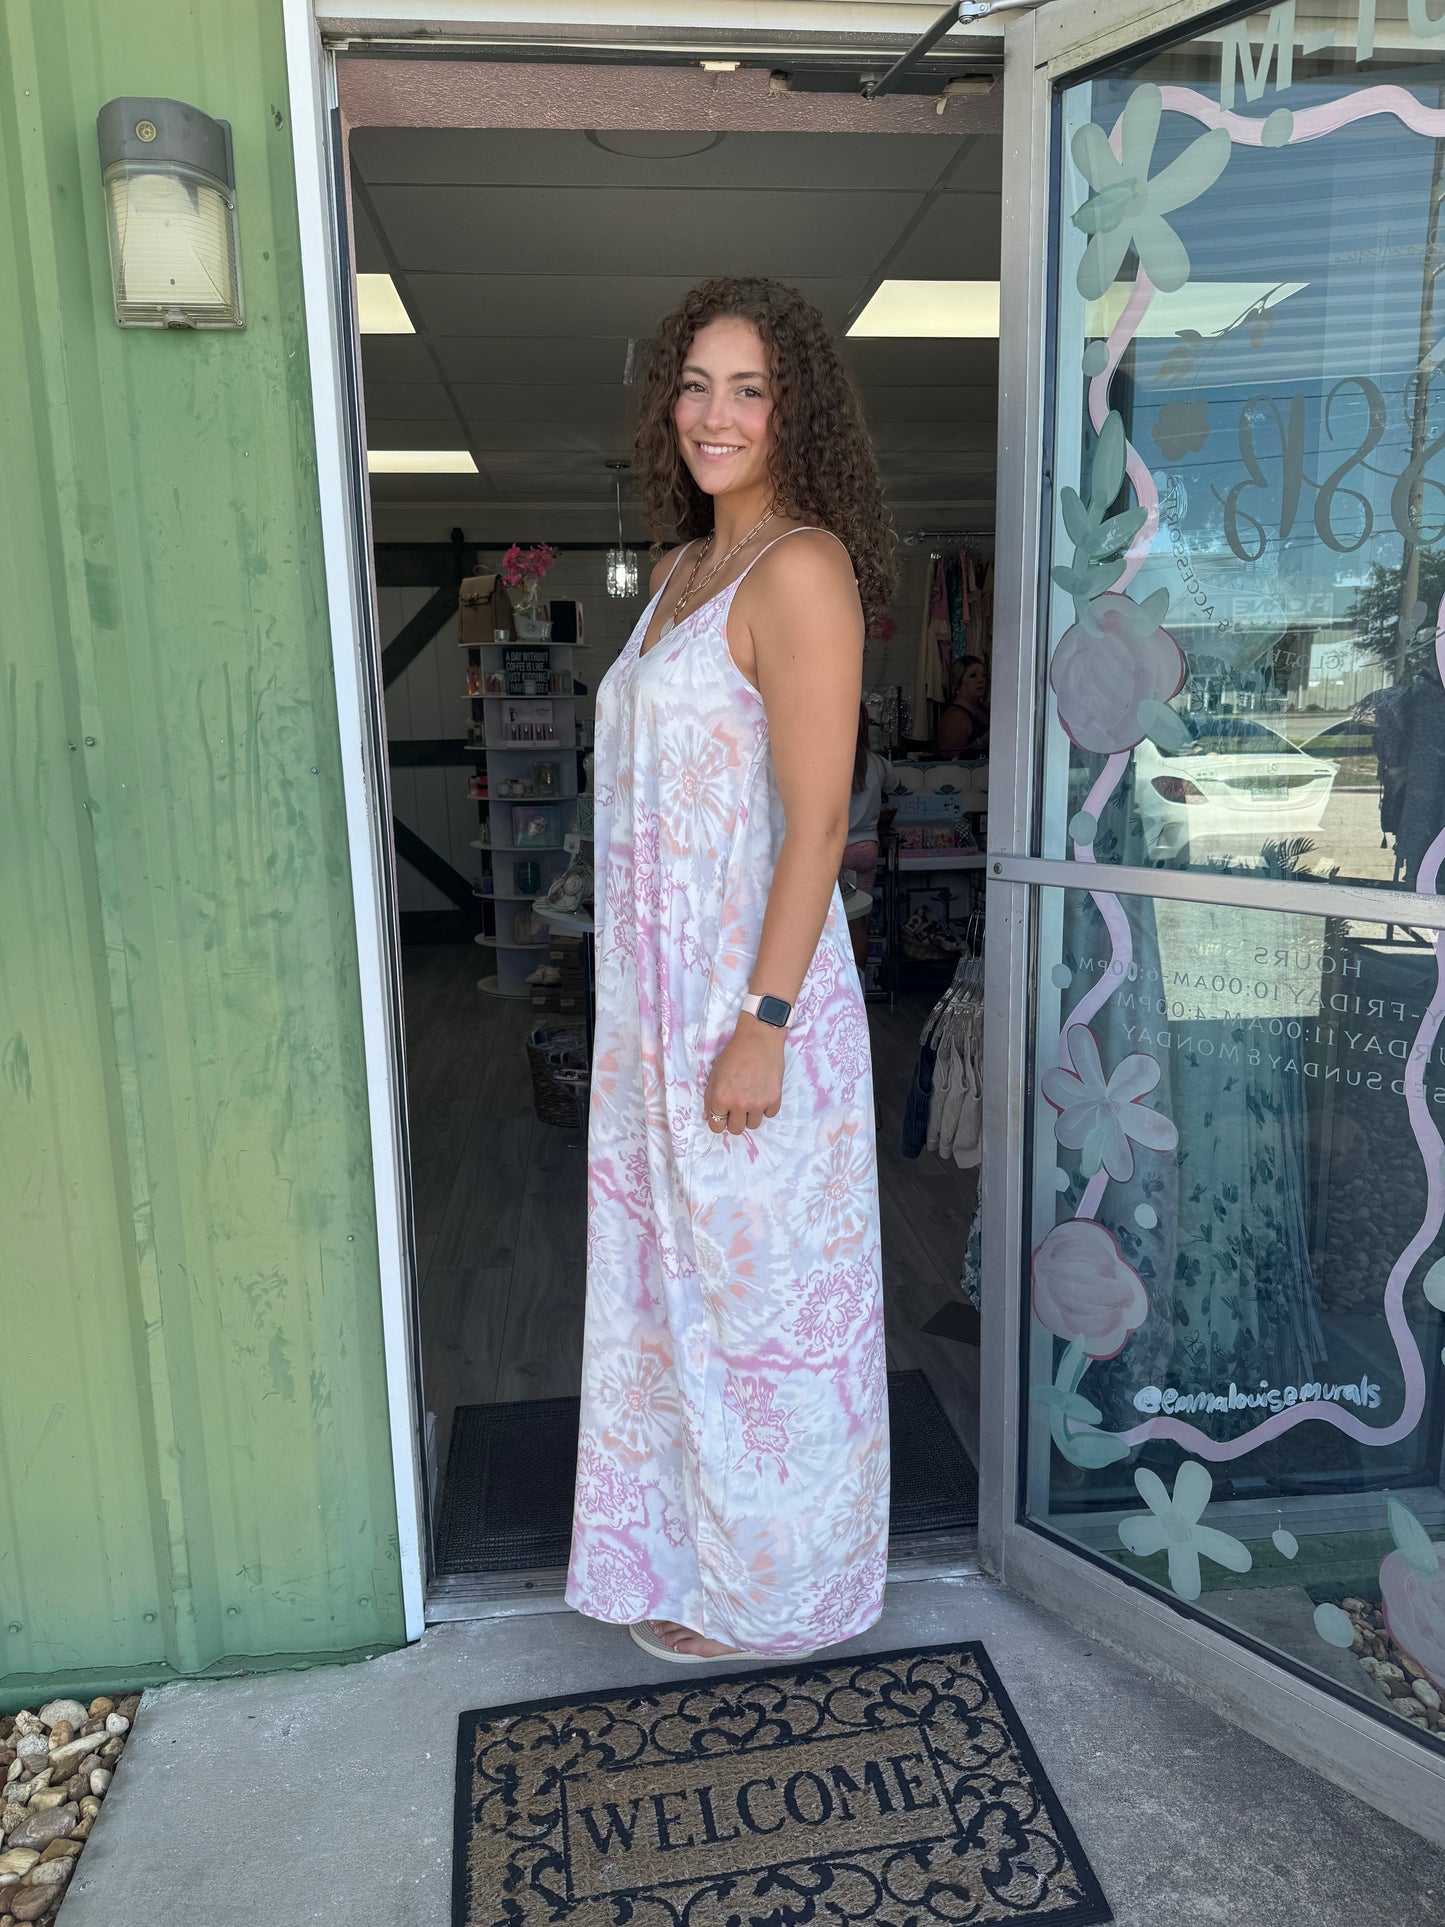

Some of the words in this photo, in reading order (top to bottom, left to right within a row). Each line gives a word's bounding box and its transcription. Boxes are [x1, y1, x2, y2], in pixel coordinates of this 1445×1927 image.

[506, 662, 526, 672] COFFEE
[1133, 1373, 1382, 1414] @emmalouisemurals
[580, 1752, 940, 1856] WELCOME
